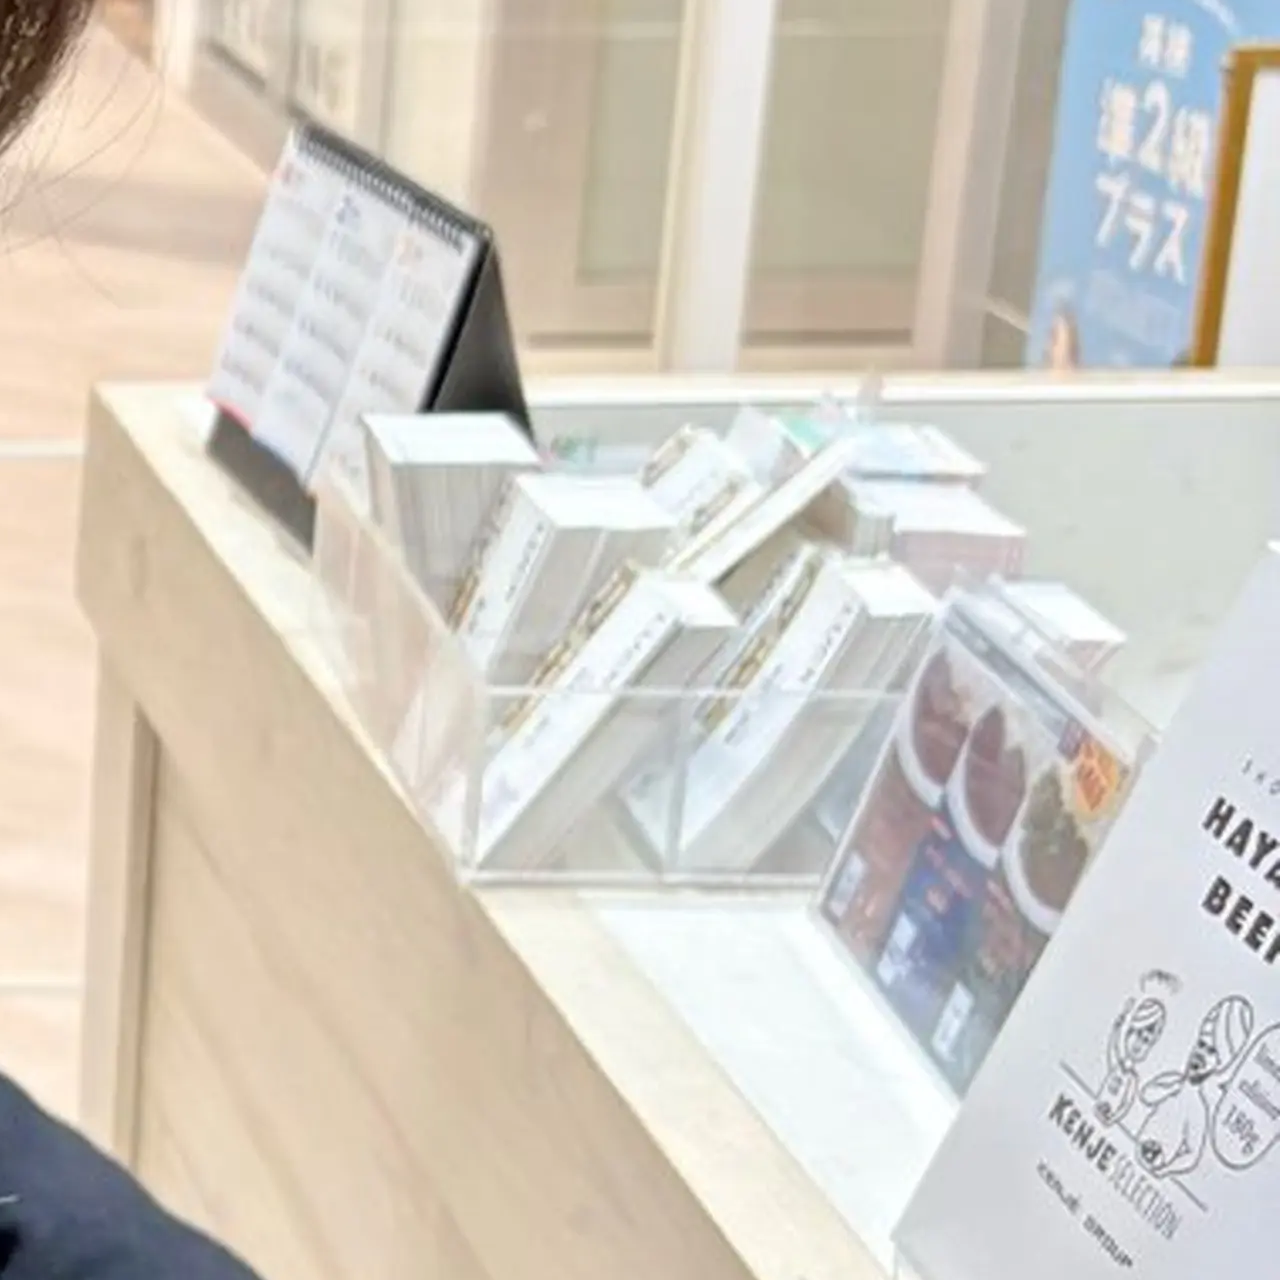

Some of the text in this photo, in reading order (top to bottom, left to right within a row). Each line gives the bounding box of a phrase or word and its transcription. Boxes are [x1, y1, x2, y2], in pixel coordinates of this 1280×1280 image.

[1095, 170, 1189, 285] プラス
[1048, 1093, 1117, 1174] KENJE
